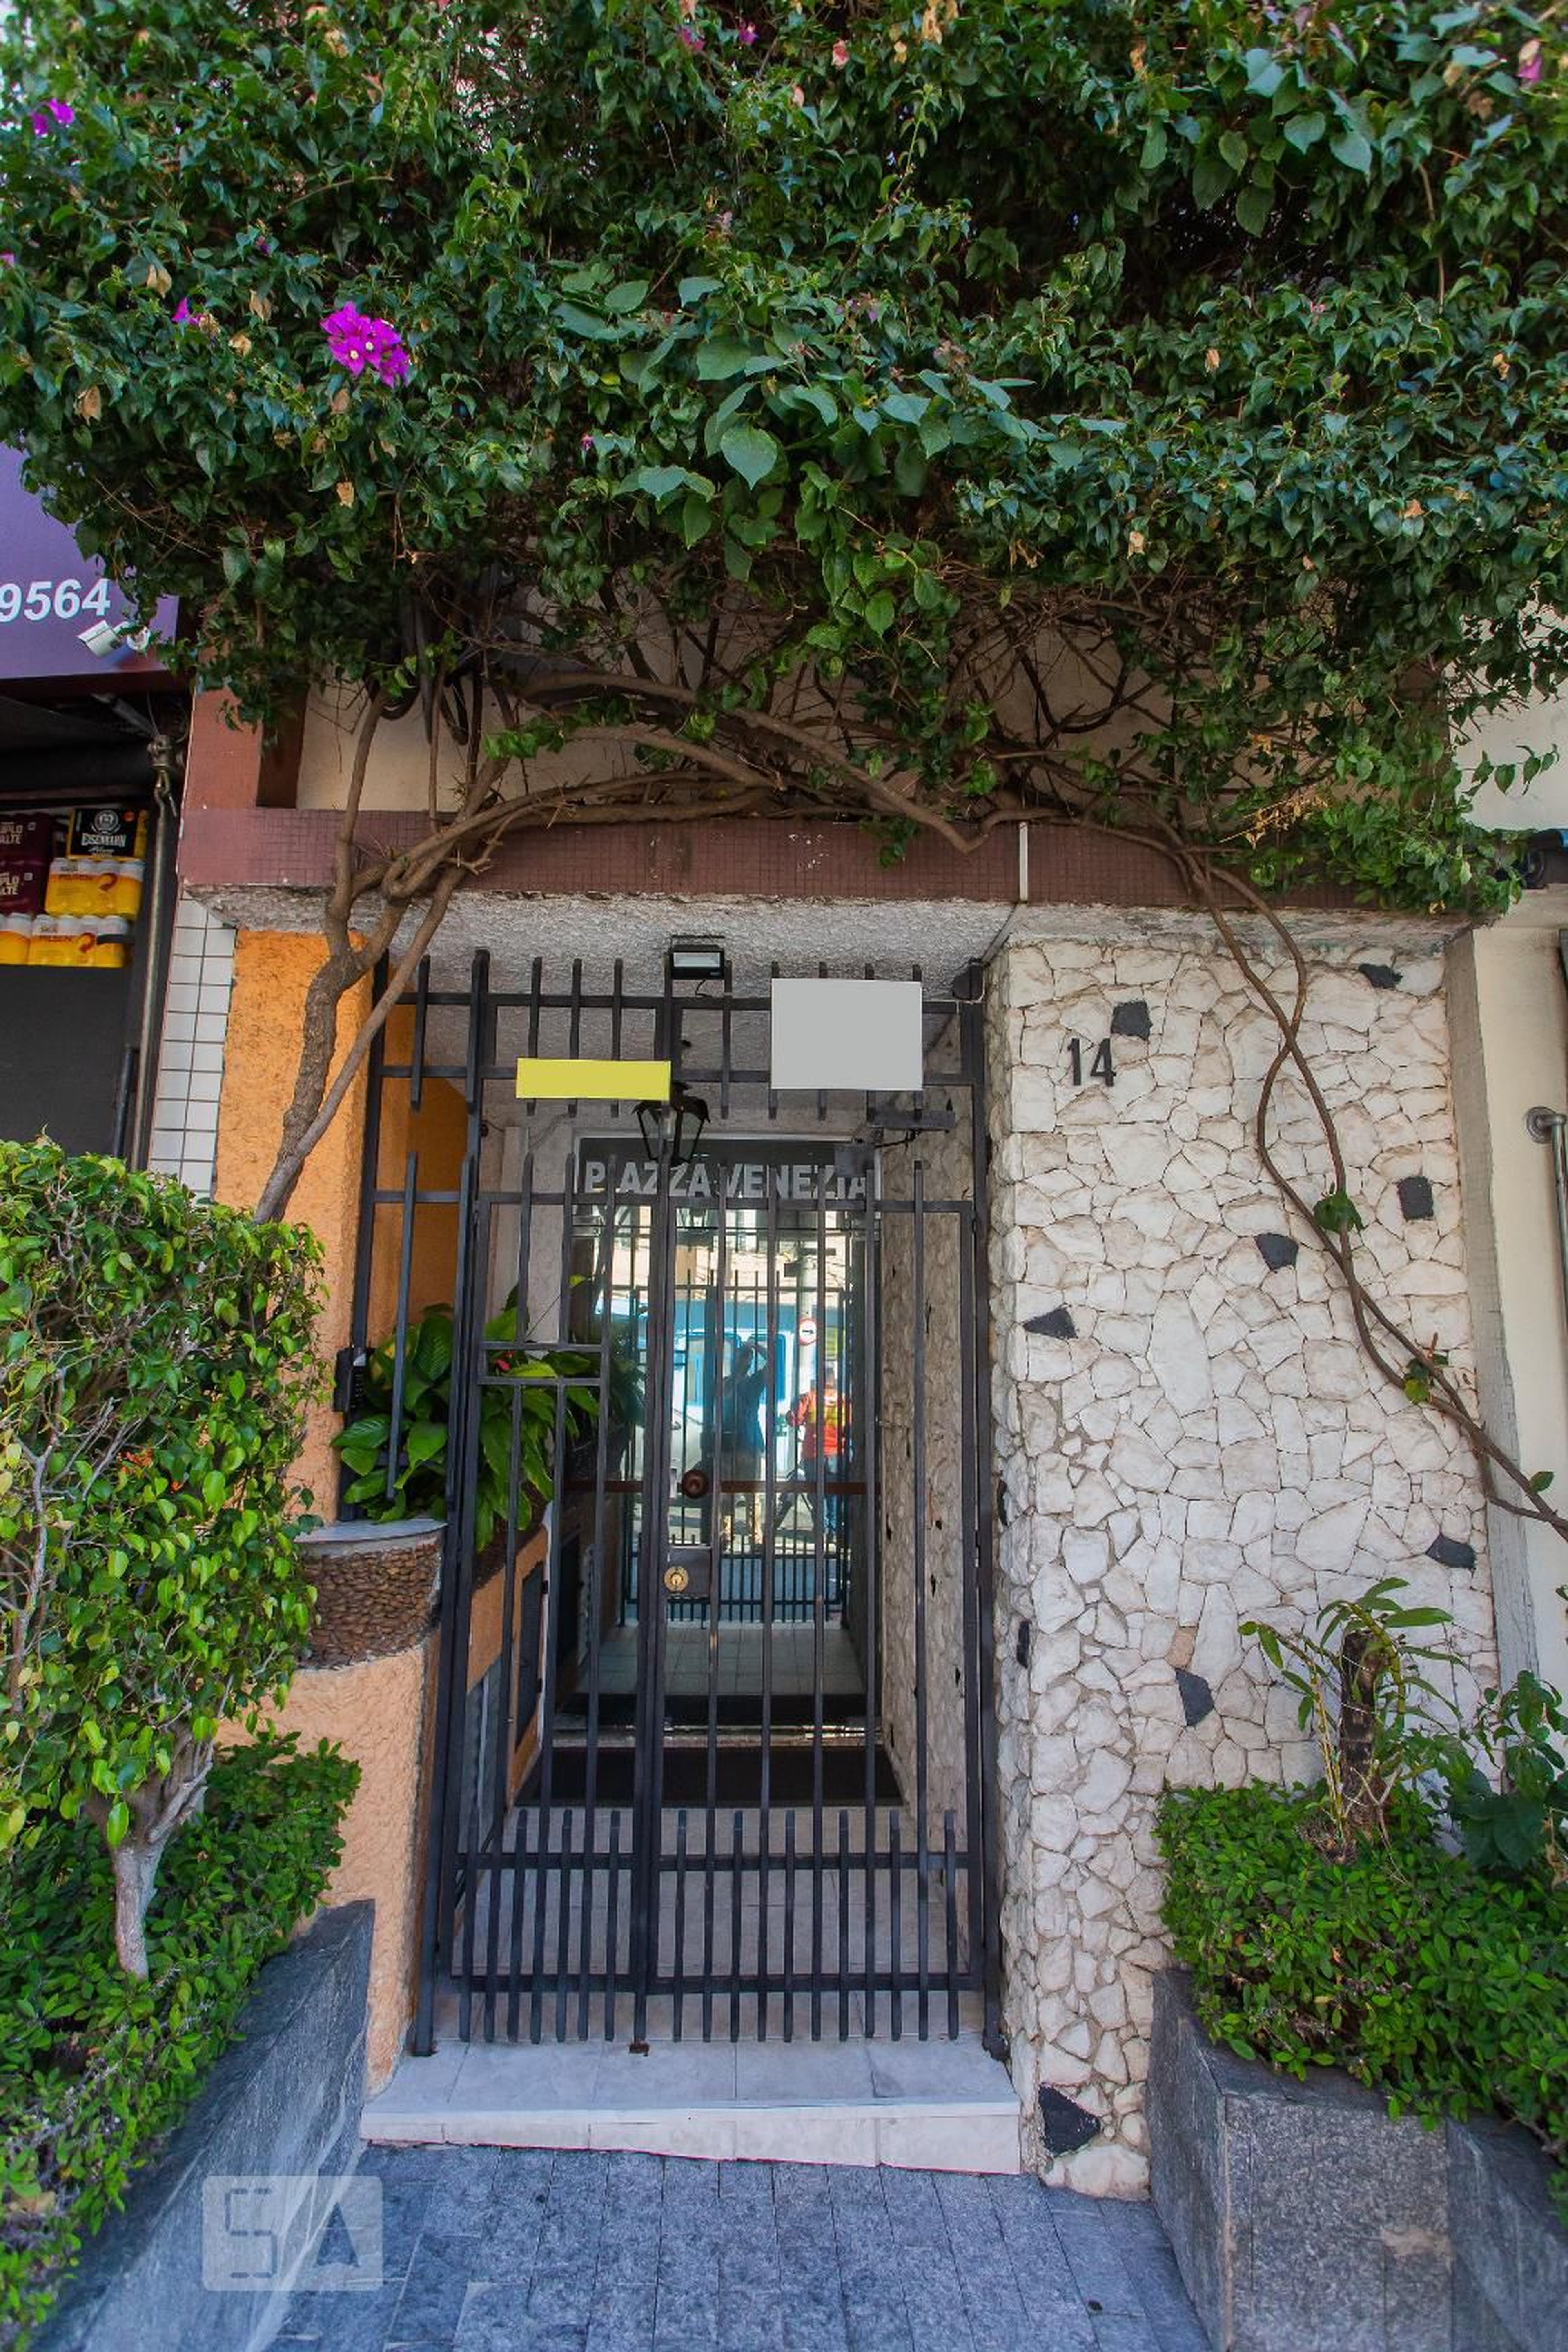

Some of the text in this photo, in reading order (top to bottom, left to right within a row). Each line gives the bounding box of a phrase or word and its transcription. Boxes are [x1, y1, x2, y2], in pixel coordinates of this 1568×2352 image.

[0, 578, 111, 622] 9564
[1067, 1038, 1116, 1087] 14
[584, 1161, 711, 1197] PAZZA
